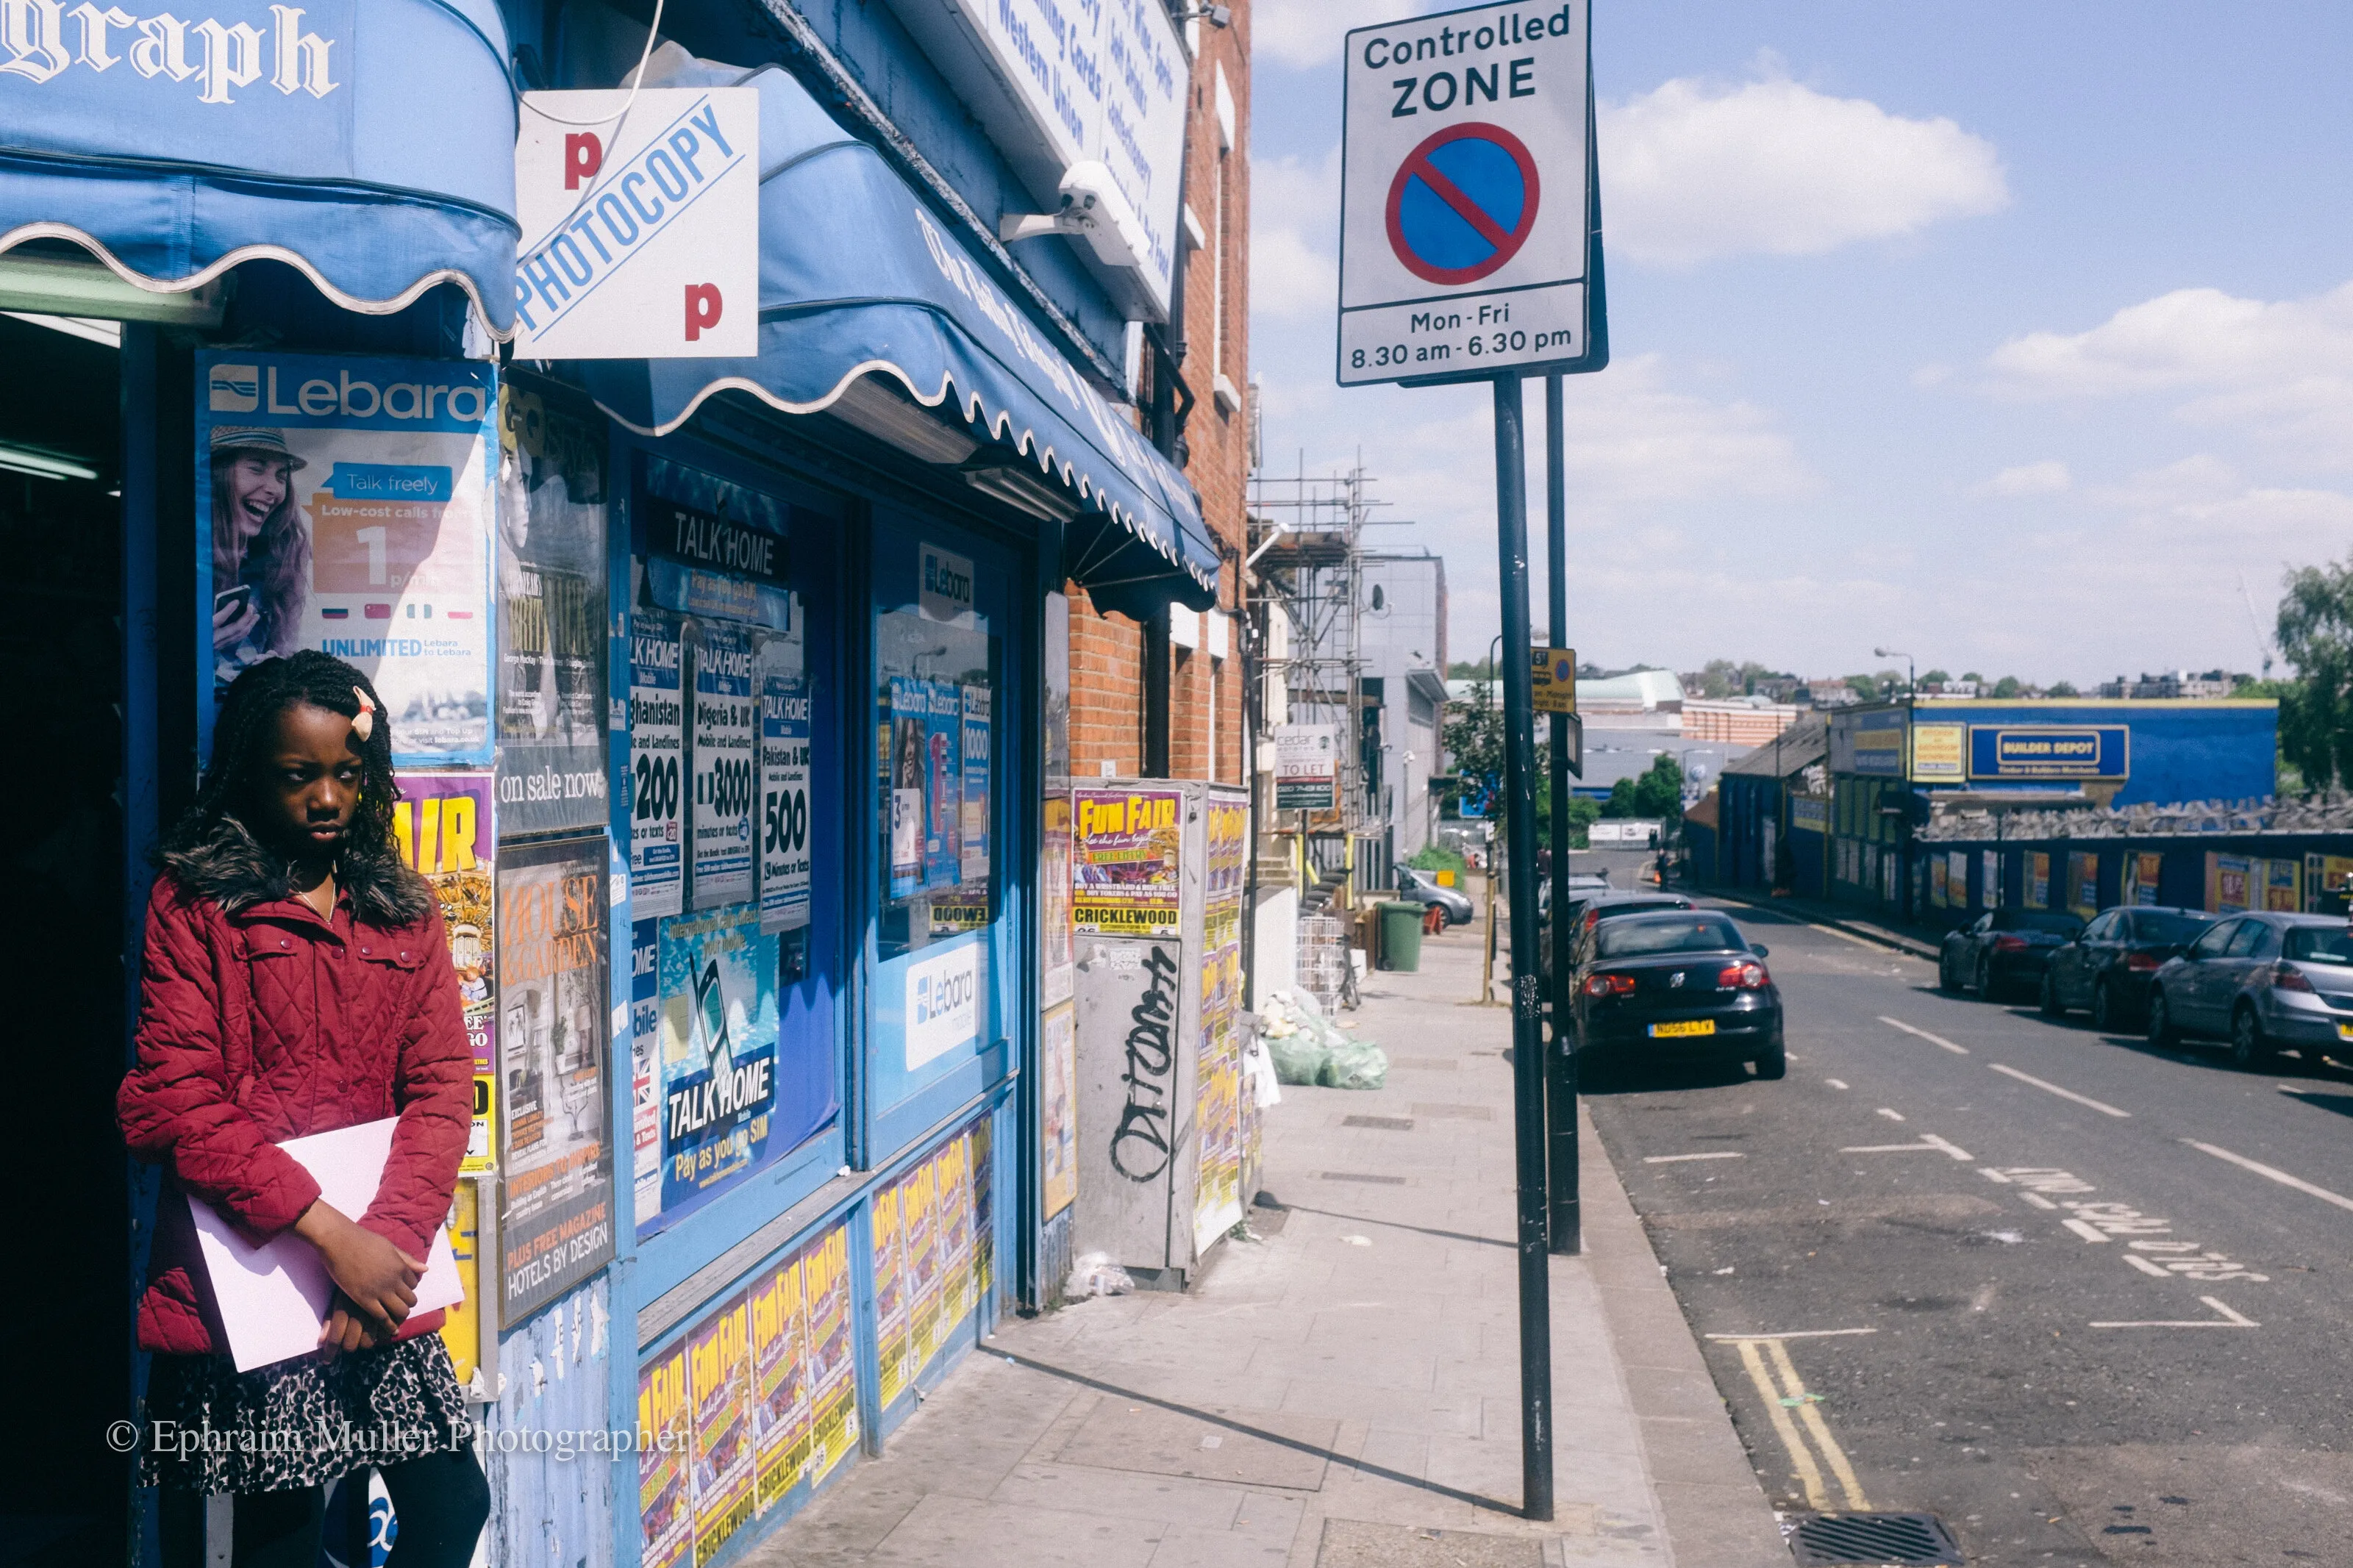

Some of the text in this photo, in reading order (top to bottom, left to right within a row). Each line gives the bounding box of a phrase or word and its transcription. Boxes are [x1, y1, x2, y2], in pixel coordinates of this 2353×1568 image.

[1363, 4, 1571, 69] Controlled
[1070, 23, 1101, 103] Cards
[1053, 64, 1084, 151] Union
[1391, 57, 1536, 118] ZONE
[565, 131, 602, 190] p
[514, 102, 734, 332] PHOTOCOPY
[685, 282, 723, 342] p
[1351, 343, 1408, 370] 8.30
[1535, 328, 1571, 353] pm
[268, 366, 486, 421] Lebara
[347, 474, 438, 495] Talk freely
[322, 504, 429, 518] Low-cost calls
[356, 526, 387, 585] 1
[675, 511, 774, 575] TALK HOME
[935, 561, 970, 603] Lebara
[322, 638, 459, 657] UNLIMITED Lebara
[437, 648, 472, 656] Lebara
[504, 654, 519, 665] George
[646, 639, 679, 668] HOME
[698, 647, 751, 679] TALK HOME
[640, 671, 656, 684] Mobile
[697, 702, 750, 730] Nigeria & UK
[763, 695, 808, 720] TALK HOME
[447, 728, 460, 736] Top
[638, 734, 679, 749] and Landlines
[698, 734, 751, 748] Mobile and Landlines
[965, 727, 988, 760] 1000
[1277, 728, 1314, 746] cedar
[2003, 742, 2094, 753] BUILDER DEPOT
[763, 745, 810, 766] Pakistan & UK
[1282, 764, 1325, 775] TO LET
[500, 776, 524, 803] on
[526, 765, 561, 801] sale
[564, 770, 601, 799] now
[636, 753, 679, 821] 200
[715, 756, 751, 817] 3000
[641, 825, 664, 839] or texts
[697, 824, 738, 839] minutes or texts
[765, 789, 806, 853] 500
[893, 795, 901, 830] 3
[1079, 796, 1176, 840] FUN FAIR
[1084, 832, 1130, 846] Let the fun
[1092, 850, 1147, 862] FREE ENTRY
[772, 858, 809, 876] Minutes or Texts
[502, 875, 598, 948] HOUSE
[668, 914, 718, 940] International
[1074, 908, 1176, 924] CRICKLEWOOD
[502, 931, 598, 987] & GARDEN
[704, 932, 746, 962] your mobile
[929, 969, 972, 1019] Lebara
[511, 1100, 538, 1120] EXCLUSIVE
[669, 1077, 719, 1139] TALK
[720, 1057, 770, 1117] HOME
[738, 1109, 751, 1123] Mobile
[675, 1153, 697, 1182] Pay
[699, 1147, 712, 1170] as
[714, 1137, 734, 1169] you
[735, 1129, 749, 1158] go
[750, 1113, 768, 1143] SIM
[510, 1162, 554, 1199] INTERIORS
[556, 1156, 568, 1174] TO
[569, 1141, 601, 1170] INSPIRE
[507, 1201, 607, 1272] PLUS FREE MAGAZINE
[508, 1222, 608, 1300] HOTELS BY DESIGN
[805, 1225, 846, 1318] FUN FAIR
[753, 1261, 803, 1361] FUN FAIR
[691, 1303, 748, 1416] FUN FAIR
[651, 1352, 686, 1437] FAIR
[813, 1387, 855, 1449] CRICKLEWOOD
[757, 1433, 811, 1506] CRICKLEWOOD
[696, 1483, 755, 1568] CRICKLEWOOD
